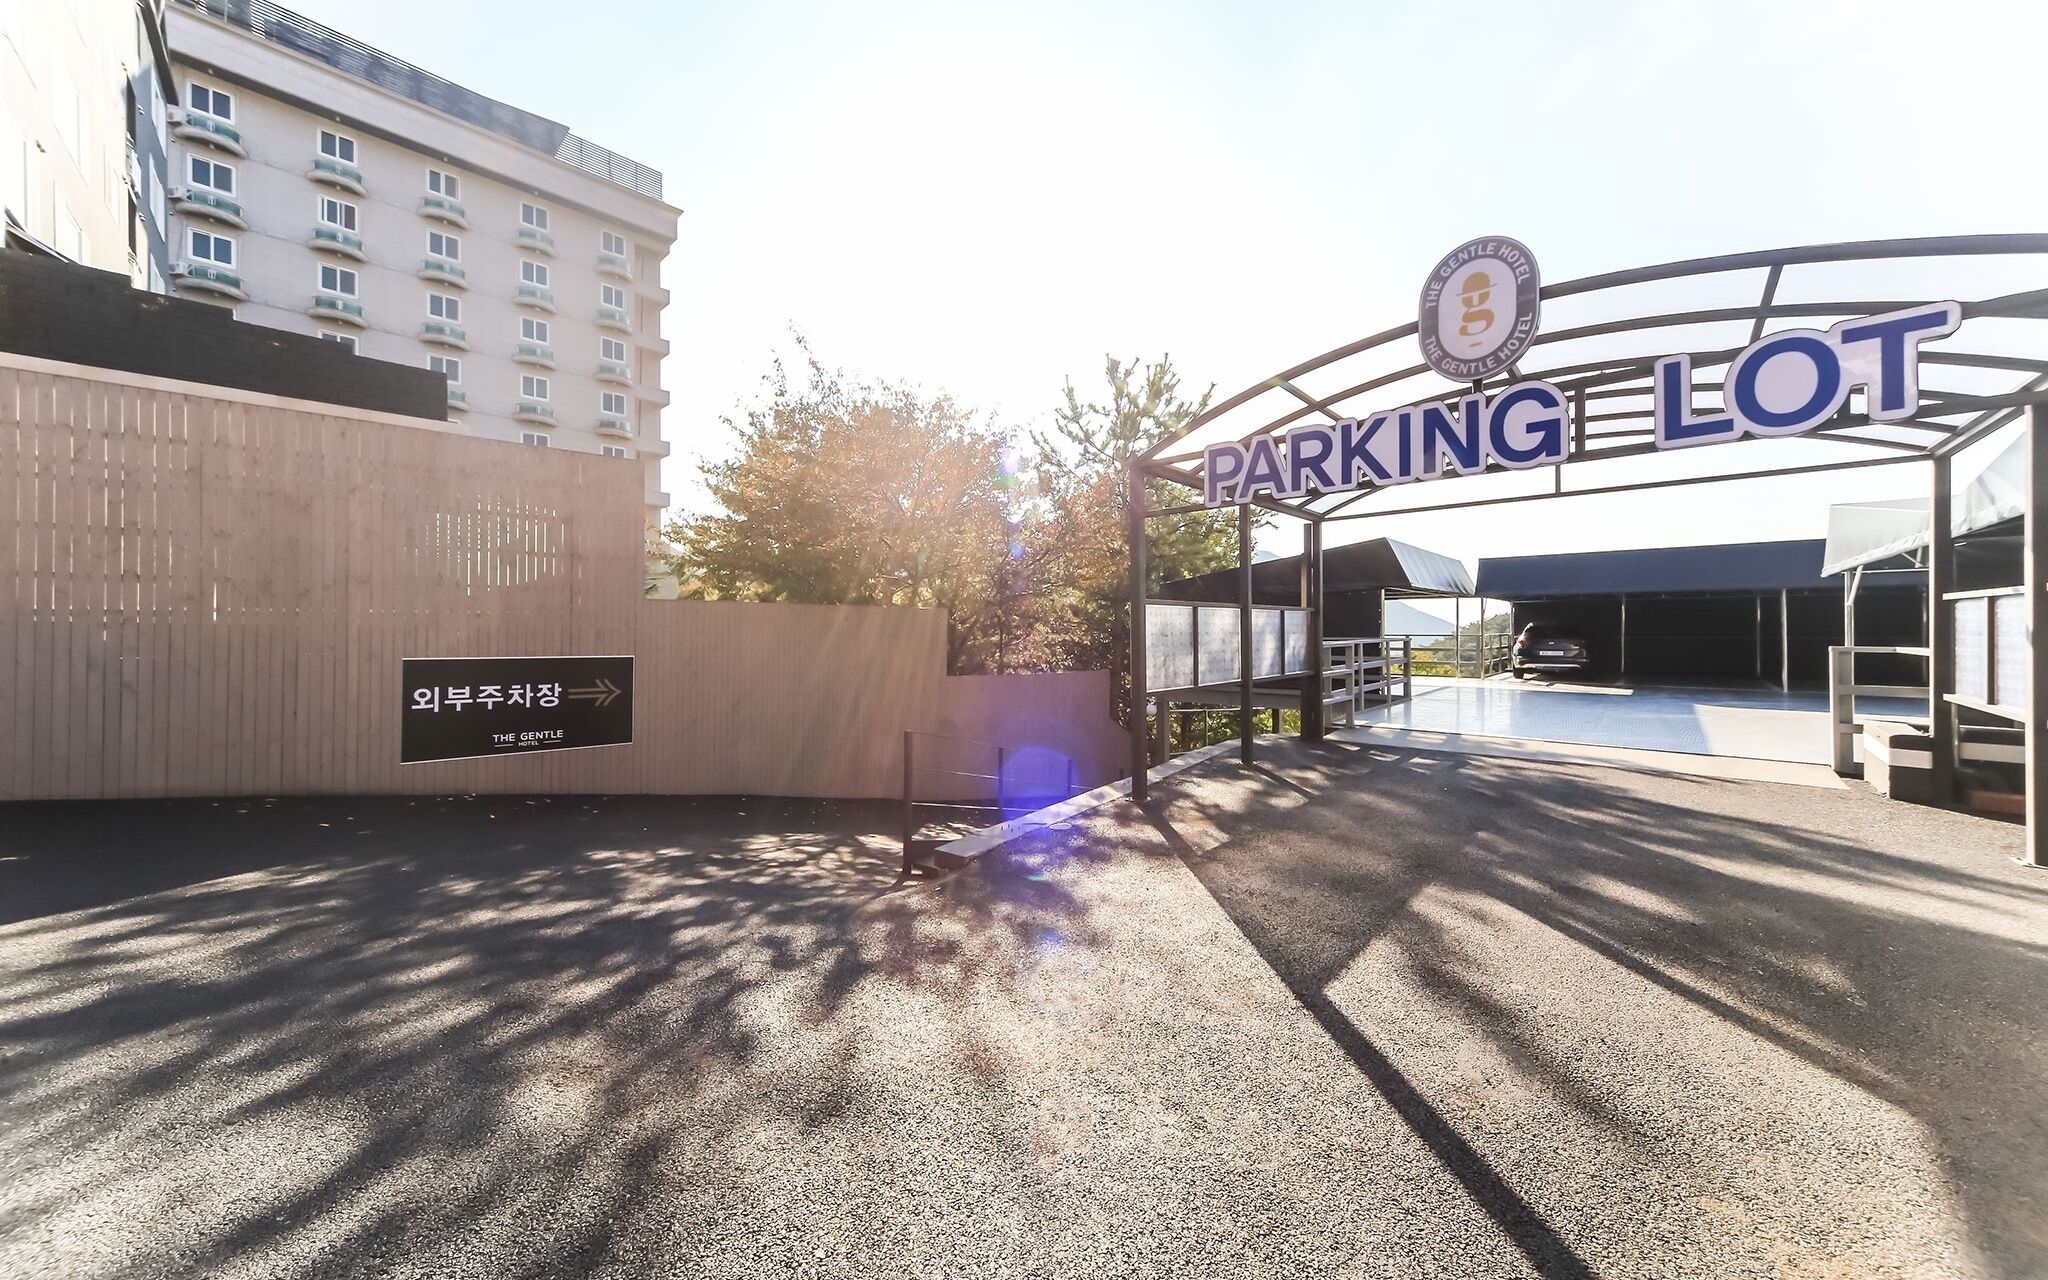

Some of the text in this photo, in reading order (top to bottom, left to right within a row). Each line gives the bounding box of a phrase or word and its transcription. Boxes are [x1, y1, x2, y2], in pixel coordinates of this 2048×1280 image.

[1425, 242, 1531, 309] THE GENTLE HOTEL
[1425, 312, 1532, 375] THE GENTLE HOTEL
[1207, 309, 1950, 503] PARKING LOT
[411, 682, 562, 713] 외부주차장
[492, 730, 564, 743] THE GENTLE
